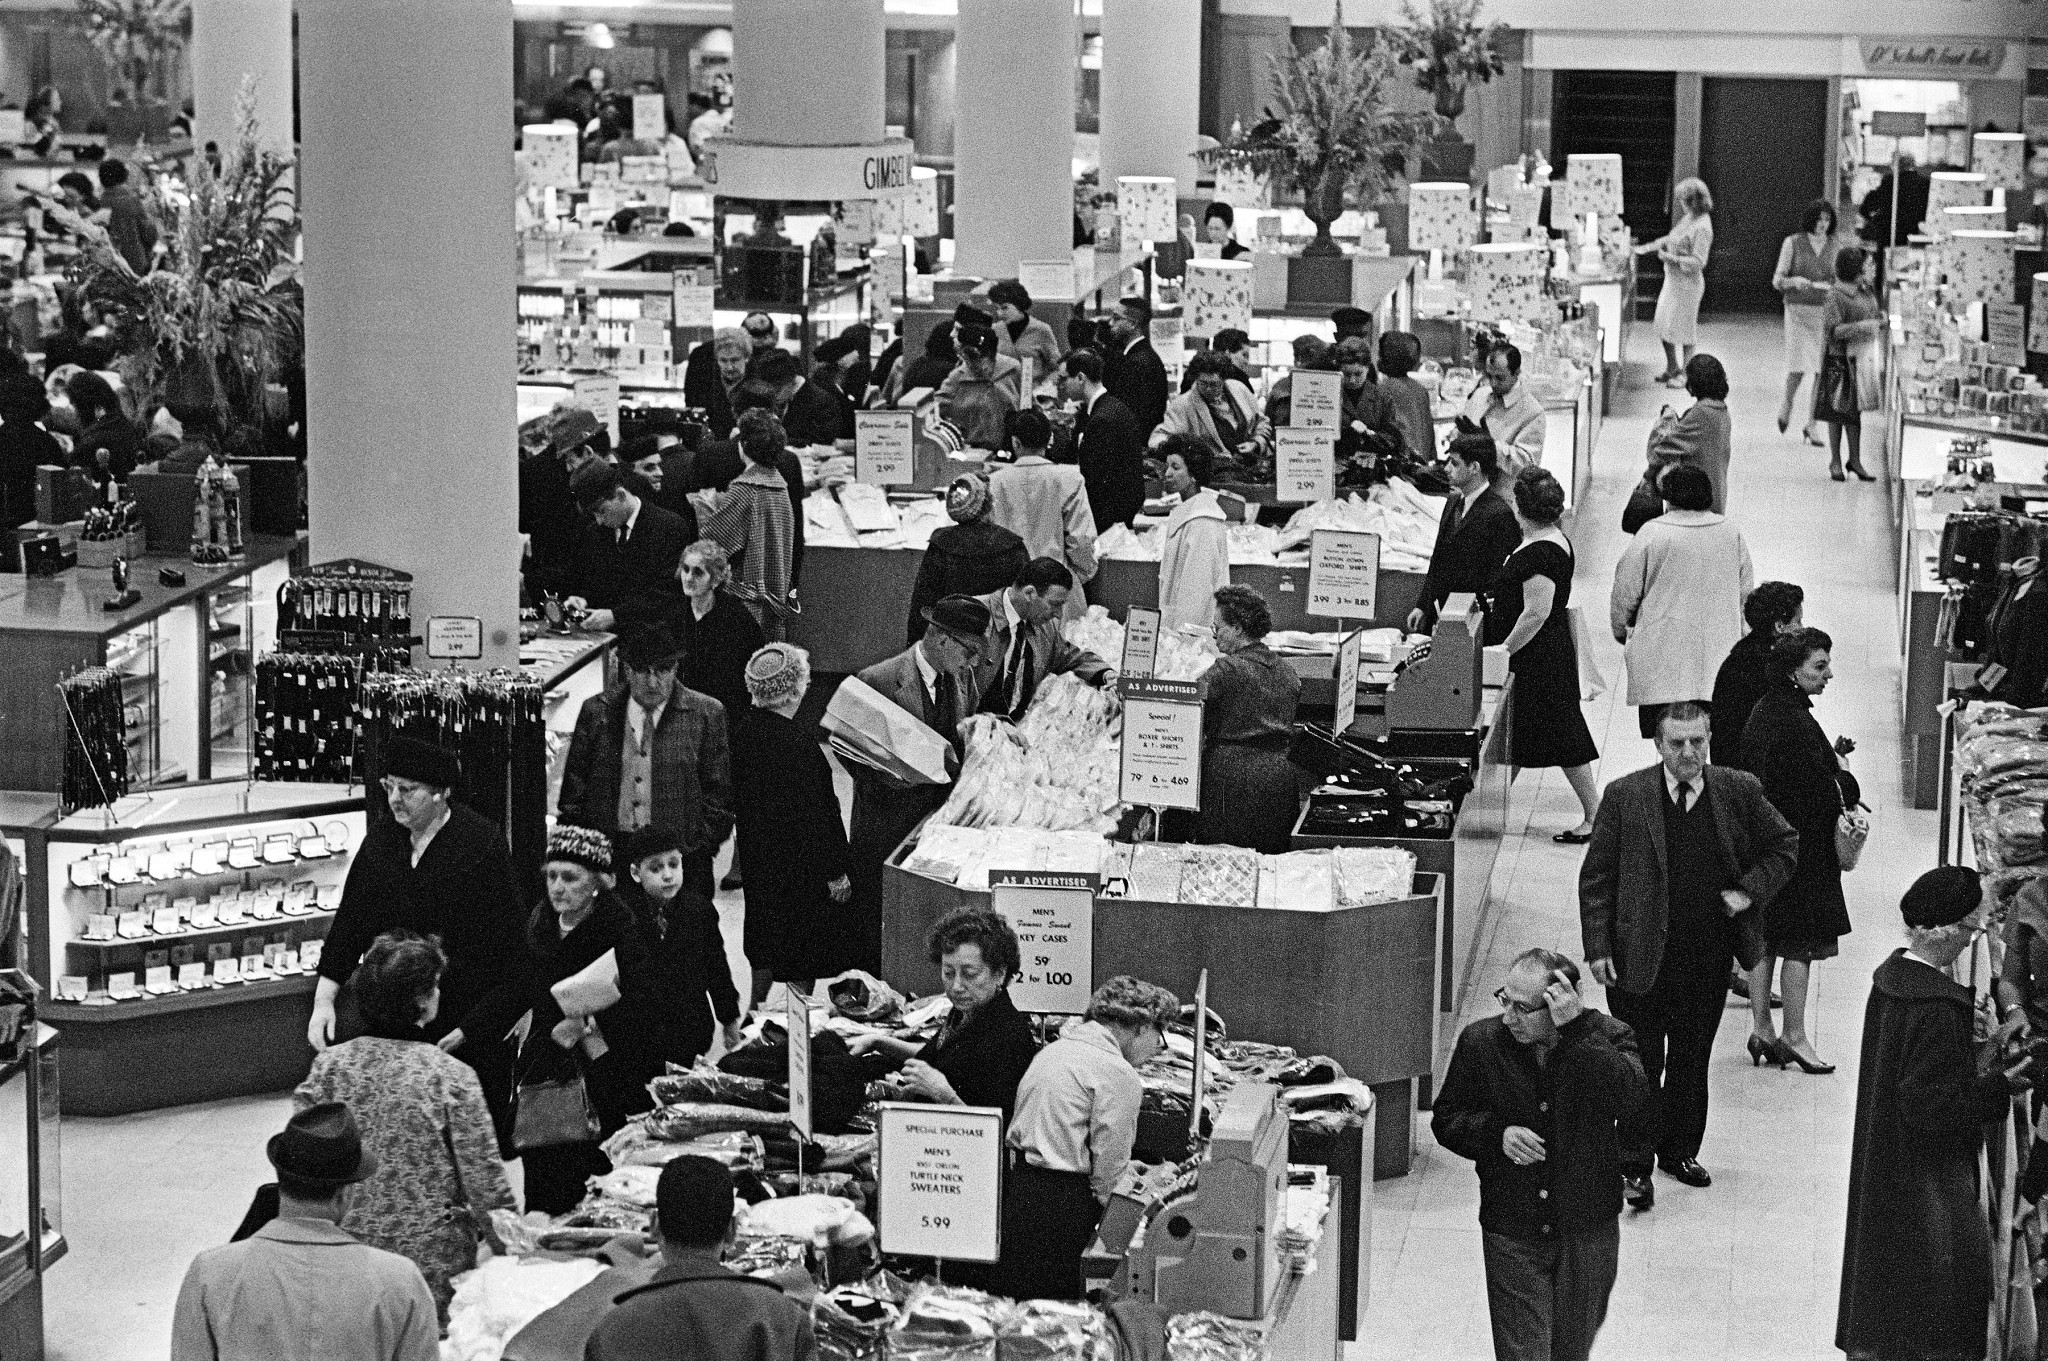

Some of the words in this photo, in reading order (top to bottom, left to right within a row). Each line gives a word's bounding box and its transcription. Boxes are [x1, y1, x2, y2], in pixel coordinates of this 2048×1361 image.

[1128, 682, 1140, 691] AS
[1145, 683, 1197, 695] ADVERTISED
[1152, 775, 1158, 783] 6
[1170, 776, 1189, 785] 4.69
[1002, 876, 1017, 885] AS
[1023, 876, 1087, 887] ADVERTISED
[1032, 908, 1055, 916] MEN'S
[1020, 934, 1036, 942] KEY
[1042, 934, 1068, 943] CASES
[1015, 971, 1024, 983] 2
[1029, 974, 1040, 983] for
[905, 1124, 936, 1134] SPECIAL
[940, 1127, 984, 1138] PURCHASE
[923, 1147, 951, 1157] MEN'S
[910, 1171, 938, 1180] TURTLE
[941, 1173, 964, 1183] NECK
[911, 1182, 961, 1195] SWEATERS
[921, 1215, 951, 1229] 5.99
